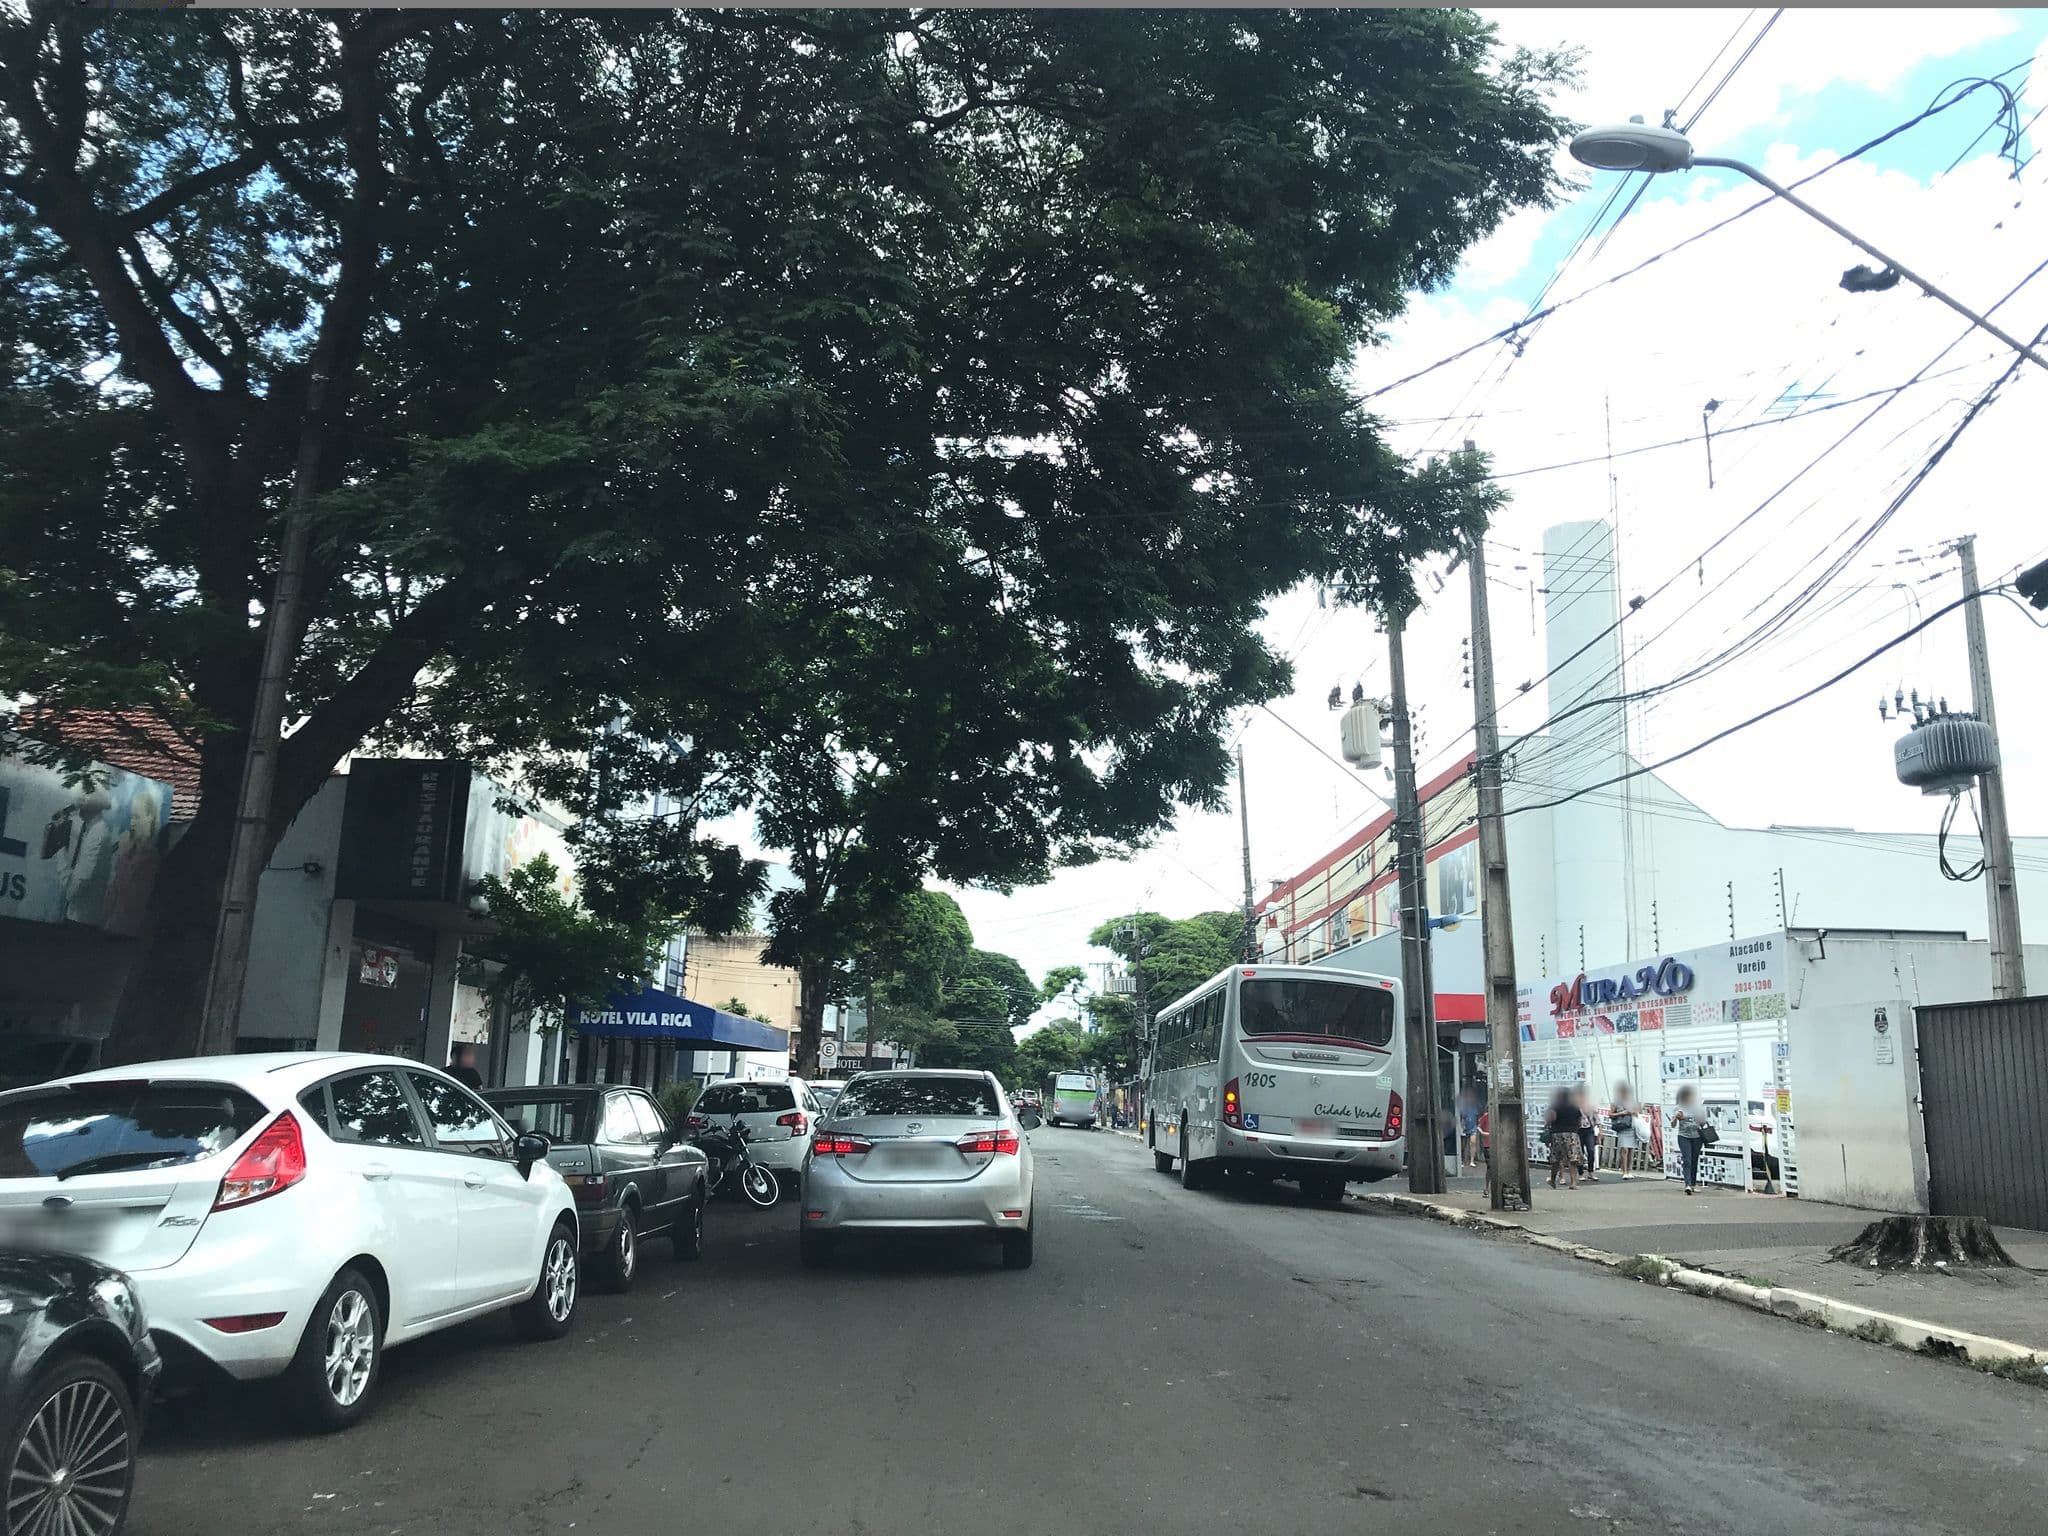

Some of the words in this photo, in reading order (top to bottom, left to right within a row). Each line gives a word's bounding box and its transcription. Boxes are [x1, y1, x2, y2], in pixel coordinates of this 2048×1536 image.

[1729, 941, 1764, 957] Atacado
[1766, 940, 1772, 950] e
[1737, 960, 1766, 974] Varejo
[580, 1010, 623, 1025] HOTEL
[626, 1011, 658, 1026] VILA
[661, 1013, 693, 1028] RICA
[1244, 1072, 1277, 1089] 1805
[1314, 1103, 1351, 1117] Cidade
[1354, 1105, 1383, 1119] Verde
